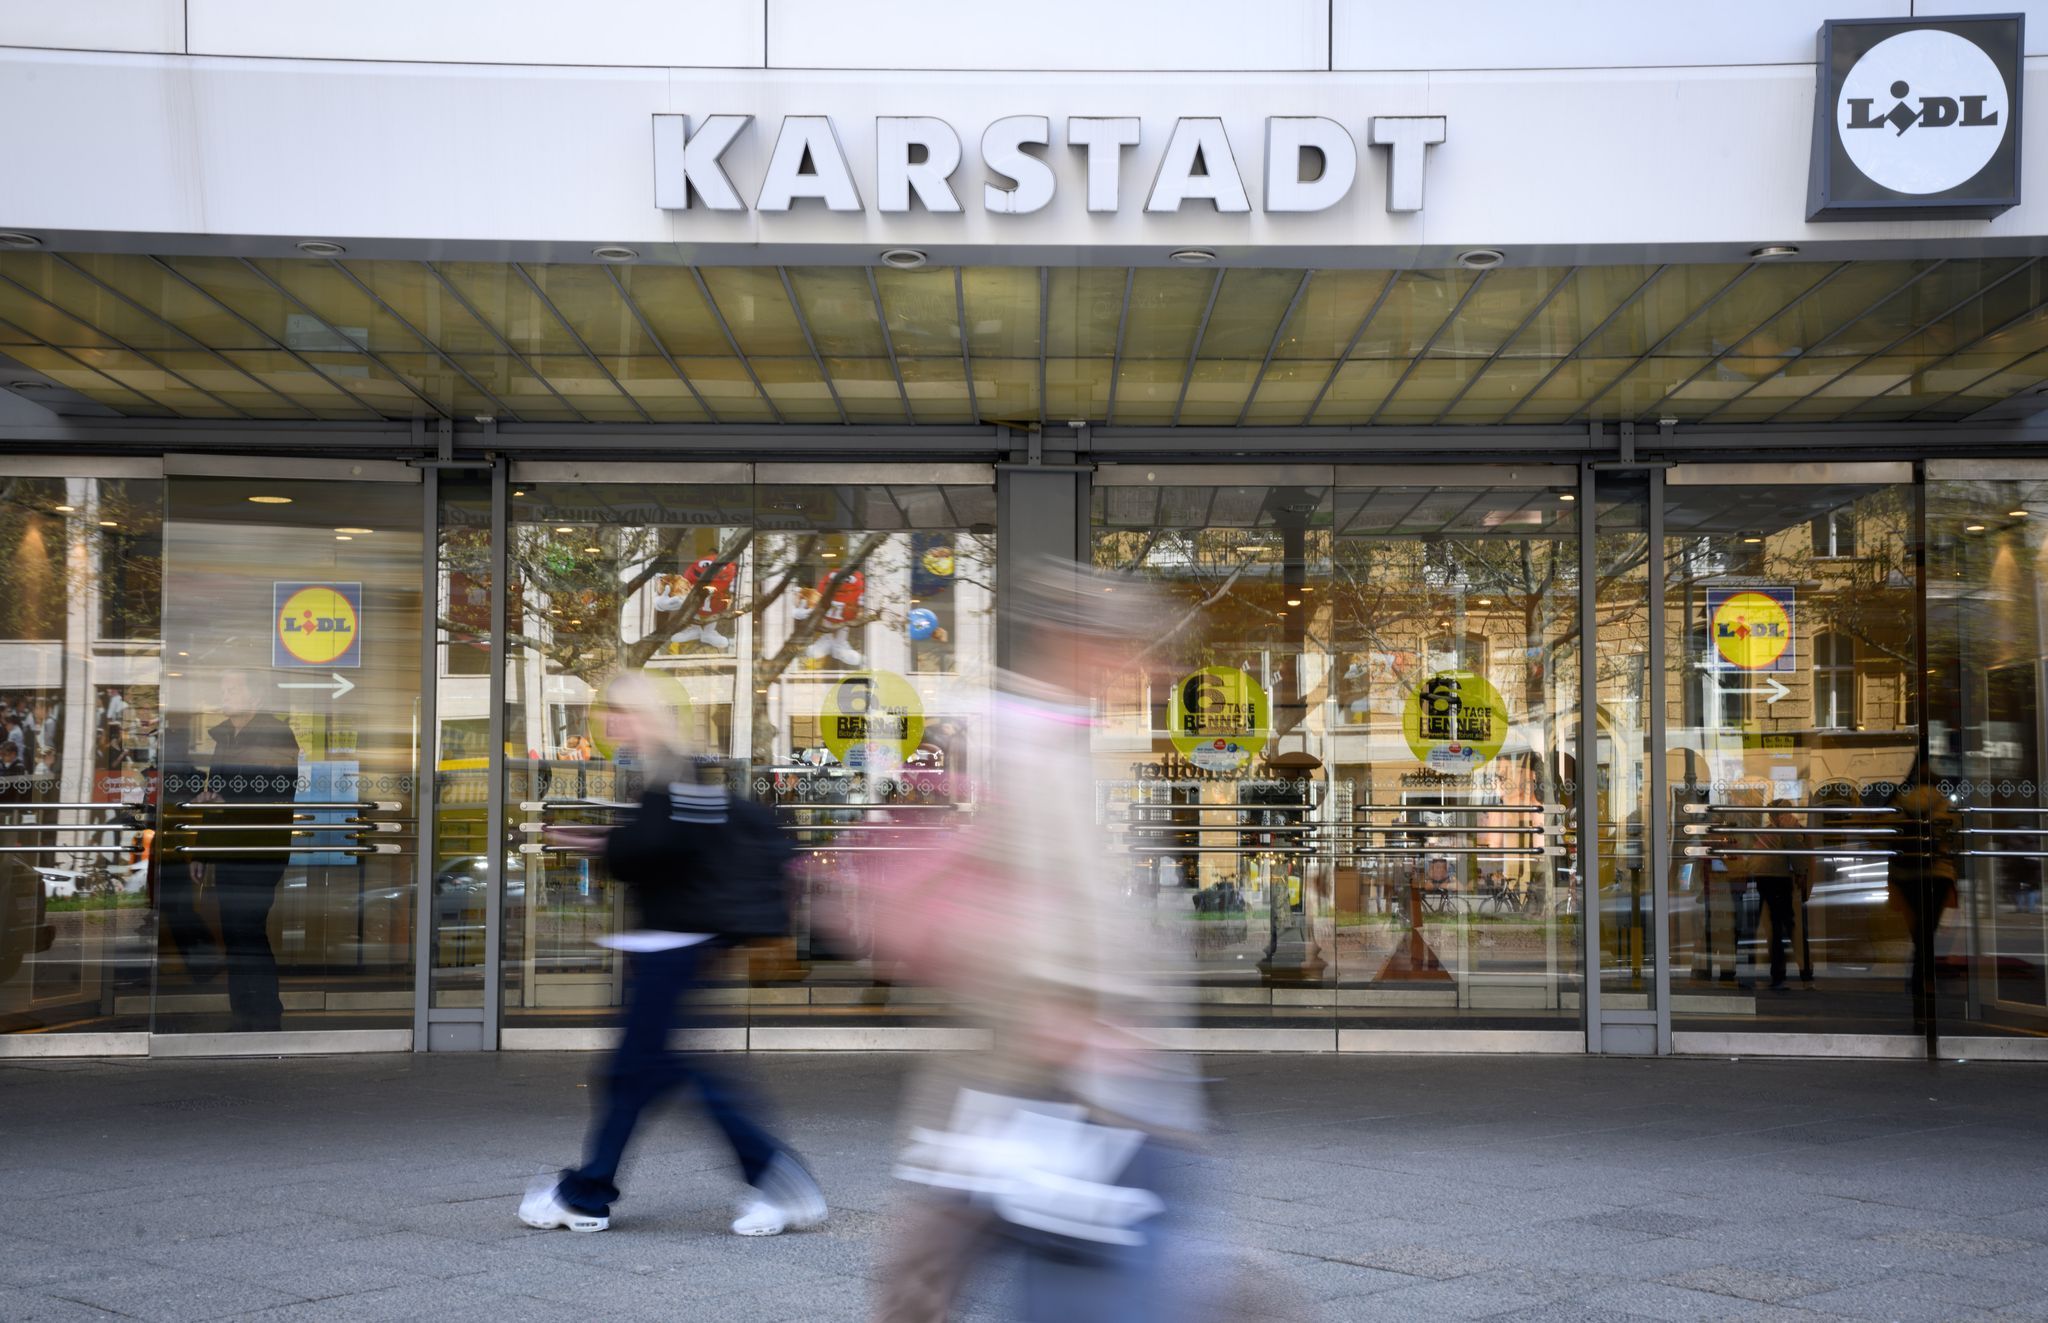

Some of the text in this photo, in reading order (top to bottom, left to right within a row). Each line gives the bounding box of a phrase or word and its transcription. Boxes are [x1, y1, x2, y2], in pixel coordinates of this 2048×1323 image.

[652, 112, 1447, 213] KARSTADT
[837, 677, 880, 714] 6
[1183, 674, 1255, 714] 6 TAGE
[1419, 677, 1492, 718] 6 TAGE
[1183, 714, 1255, 731] RENNEN
